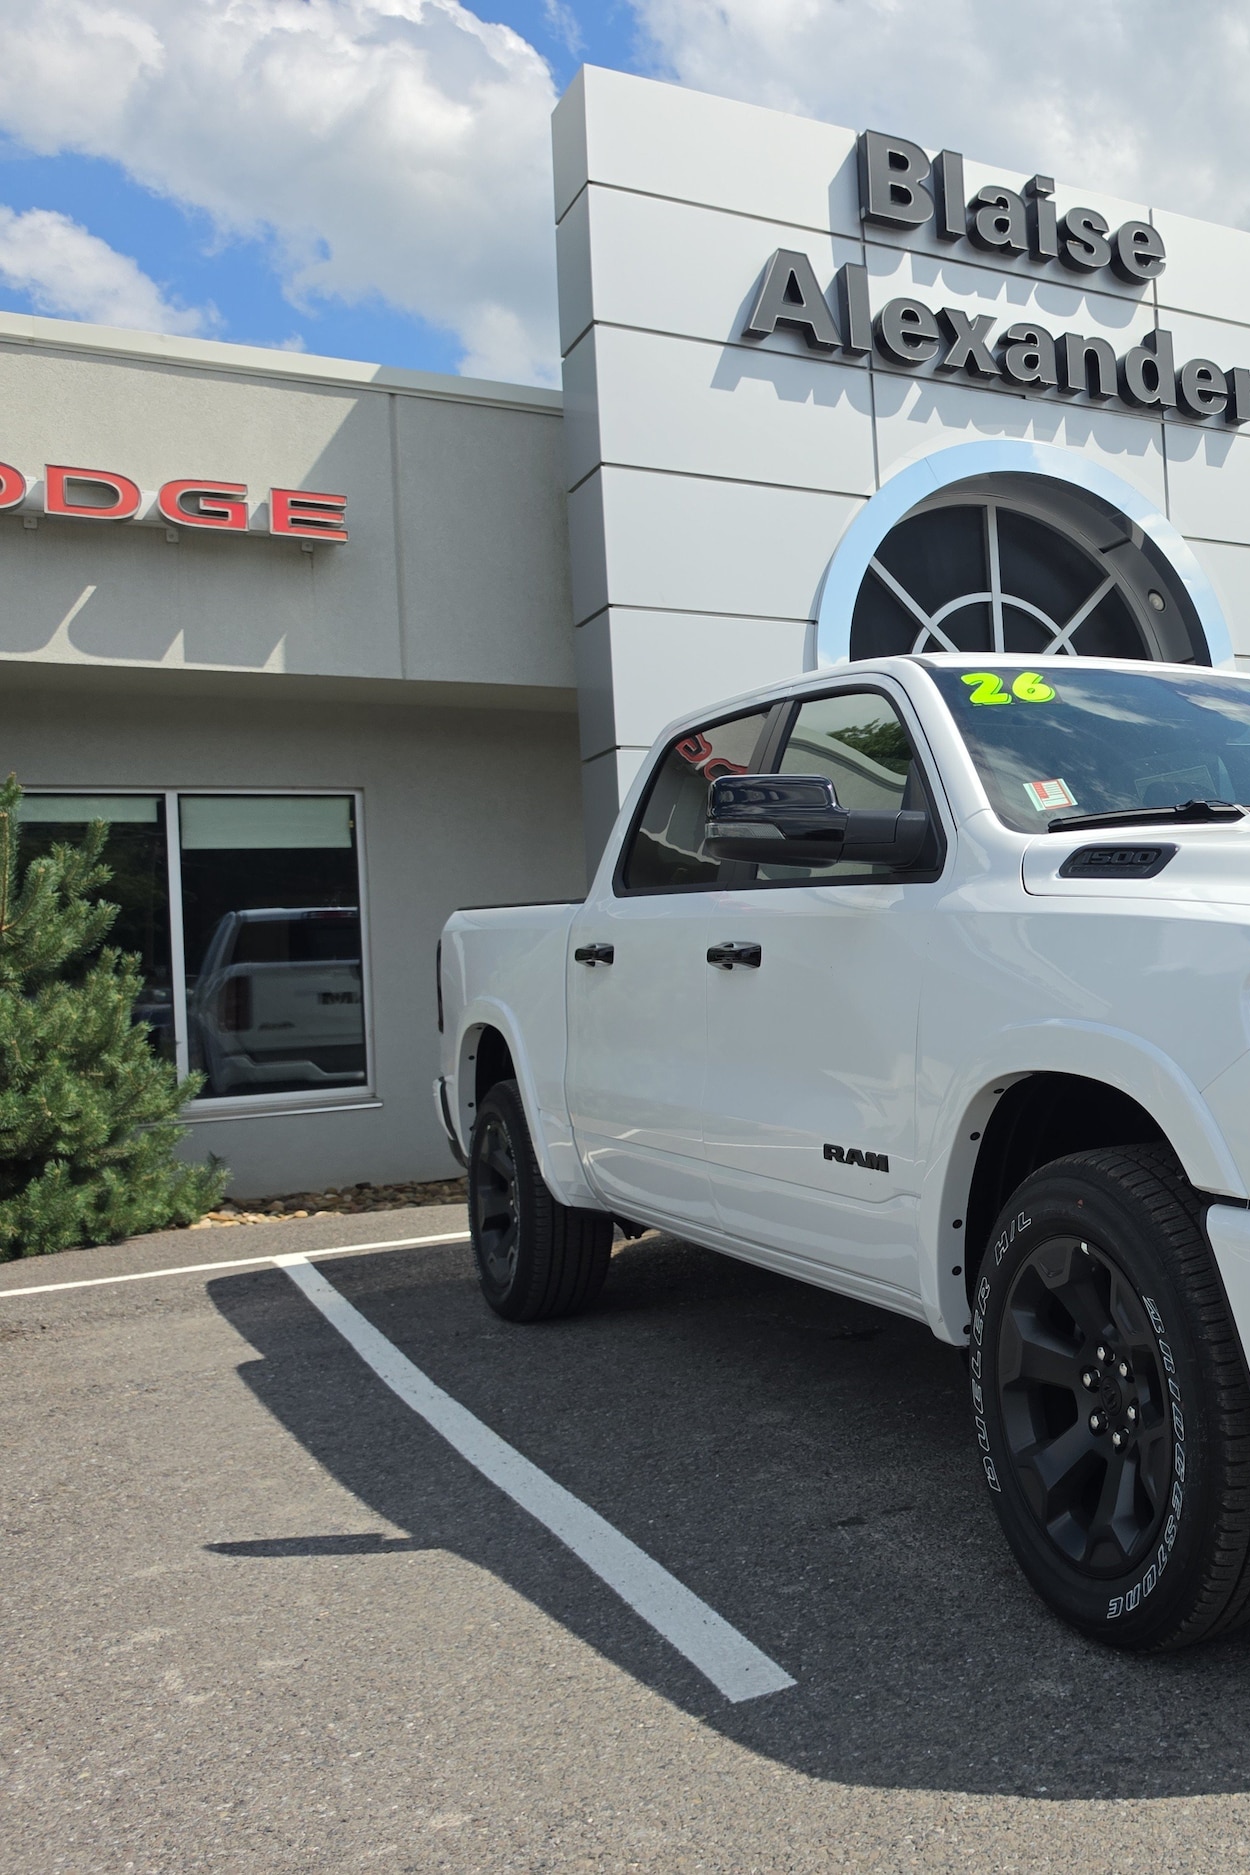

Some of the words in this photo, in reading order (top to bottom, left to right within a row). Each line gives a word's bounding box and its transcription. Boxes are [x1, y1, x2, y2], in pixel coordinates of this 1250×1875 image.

[858, 129, 1167, 285] Blaise
[0, 461, 349, 545] DGE
[961, 671, 1056, 706] 26
[1078, 850, 1158, 865] 1500
[823, 1143, 889, 1173] RAM
[1106, 1295, 1187, 1620] BRIDGESTONE
